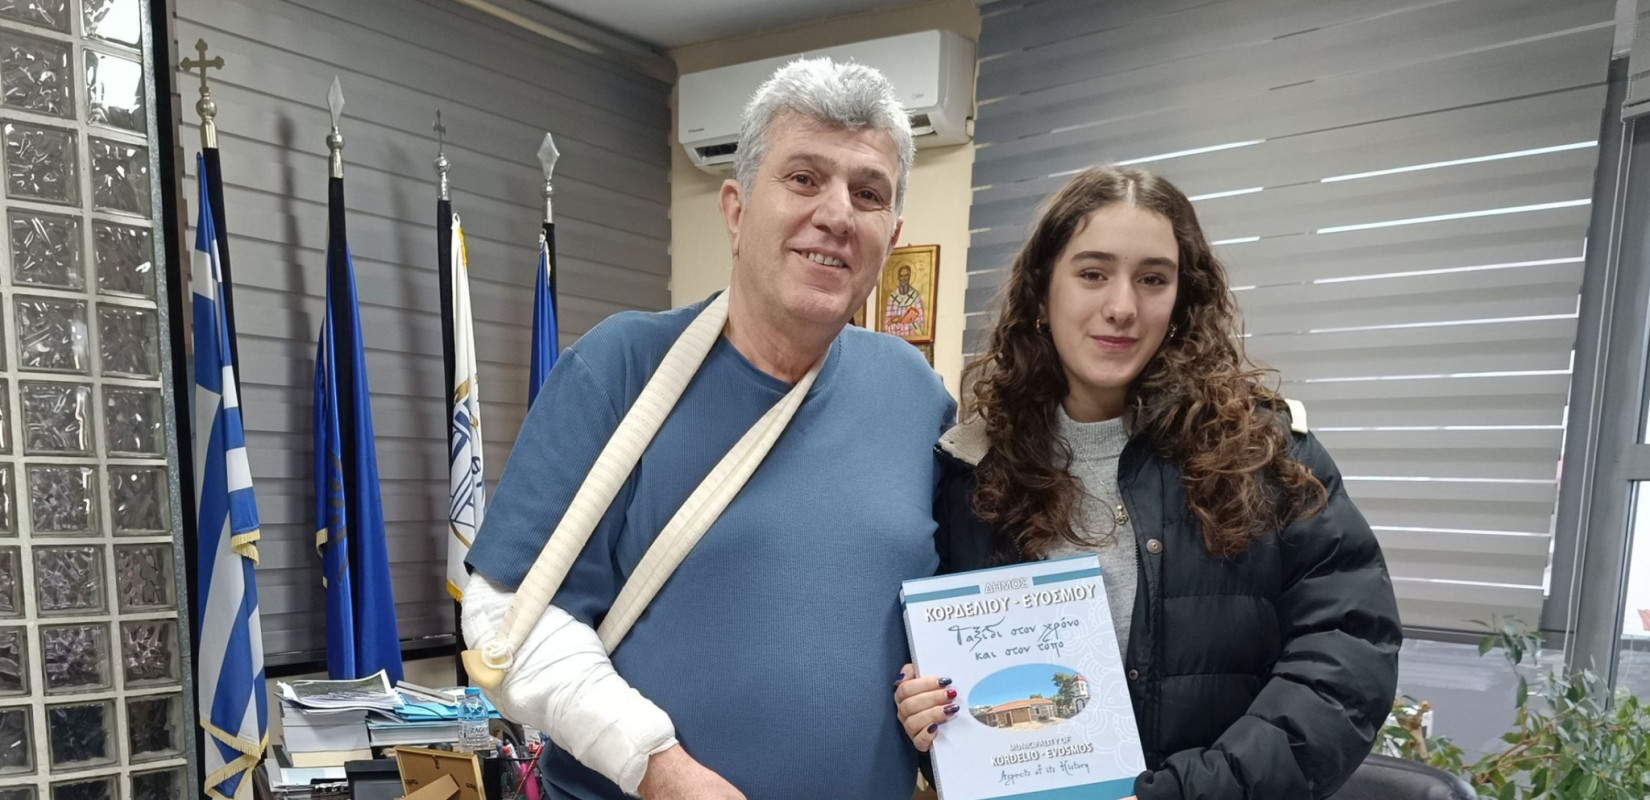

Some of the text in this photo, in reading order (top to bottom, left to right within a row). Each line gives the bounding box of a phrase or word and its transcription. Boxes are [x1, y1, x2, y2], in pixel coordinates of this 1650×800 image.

[984, 577, 1028, 593] ΔΗΜΟΣ
[924, 598, 1011, 622] ΚΟΡΔΕΛΙΟΥ
[1023, 584, 1096, 609] ΕΥΟΣΜΟΥ
[1011, 625, 1037, 637] στον
[1037, 617, 1079, 642] χρόνο
[975, 651, 996, 661] και
[1005, 645, 1031, 656] στον
[991, 750, 1040, 767] KORDELIO
[1046, 742, 1094, 759] EVOSMOS
